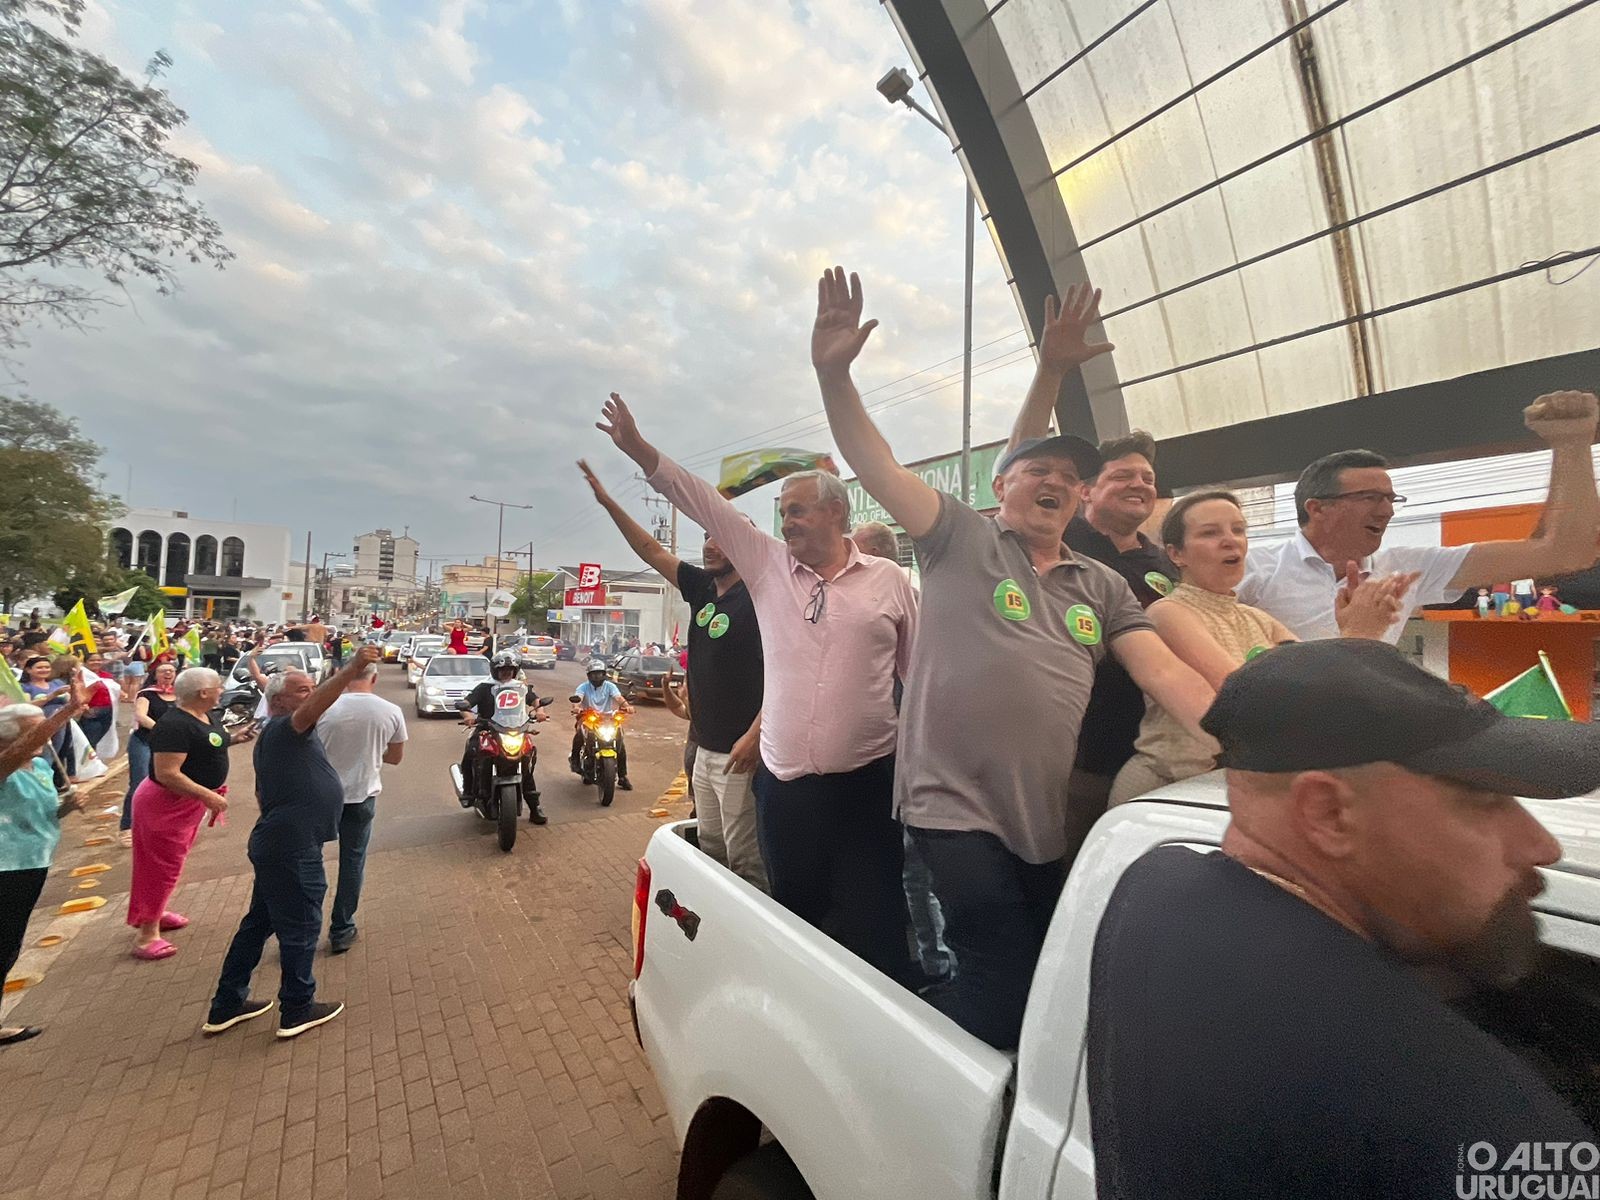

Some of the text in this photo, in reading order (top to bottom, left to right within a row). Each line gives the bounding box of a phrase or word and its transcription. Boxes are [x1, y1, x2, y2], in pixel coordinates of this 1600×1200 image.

[573, 592, 595, 604] BENOIT
[1007, 594, 1022, 607] 15
[1078, 618, 1093, 632] 15
[498, 692, 519, 708] 15
